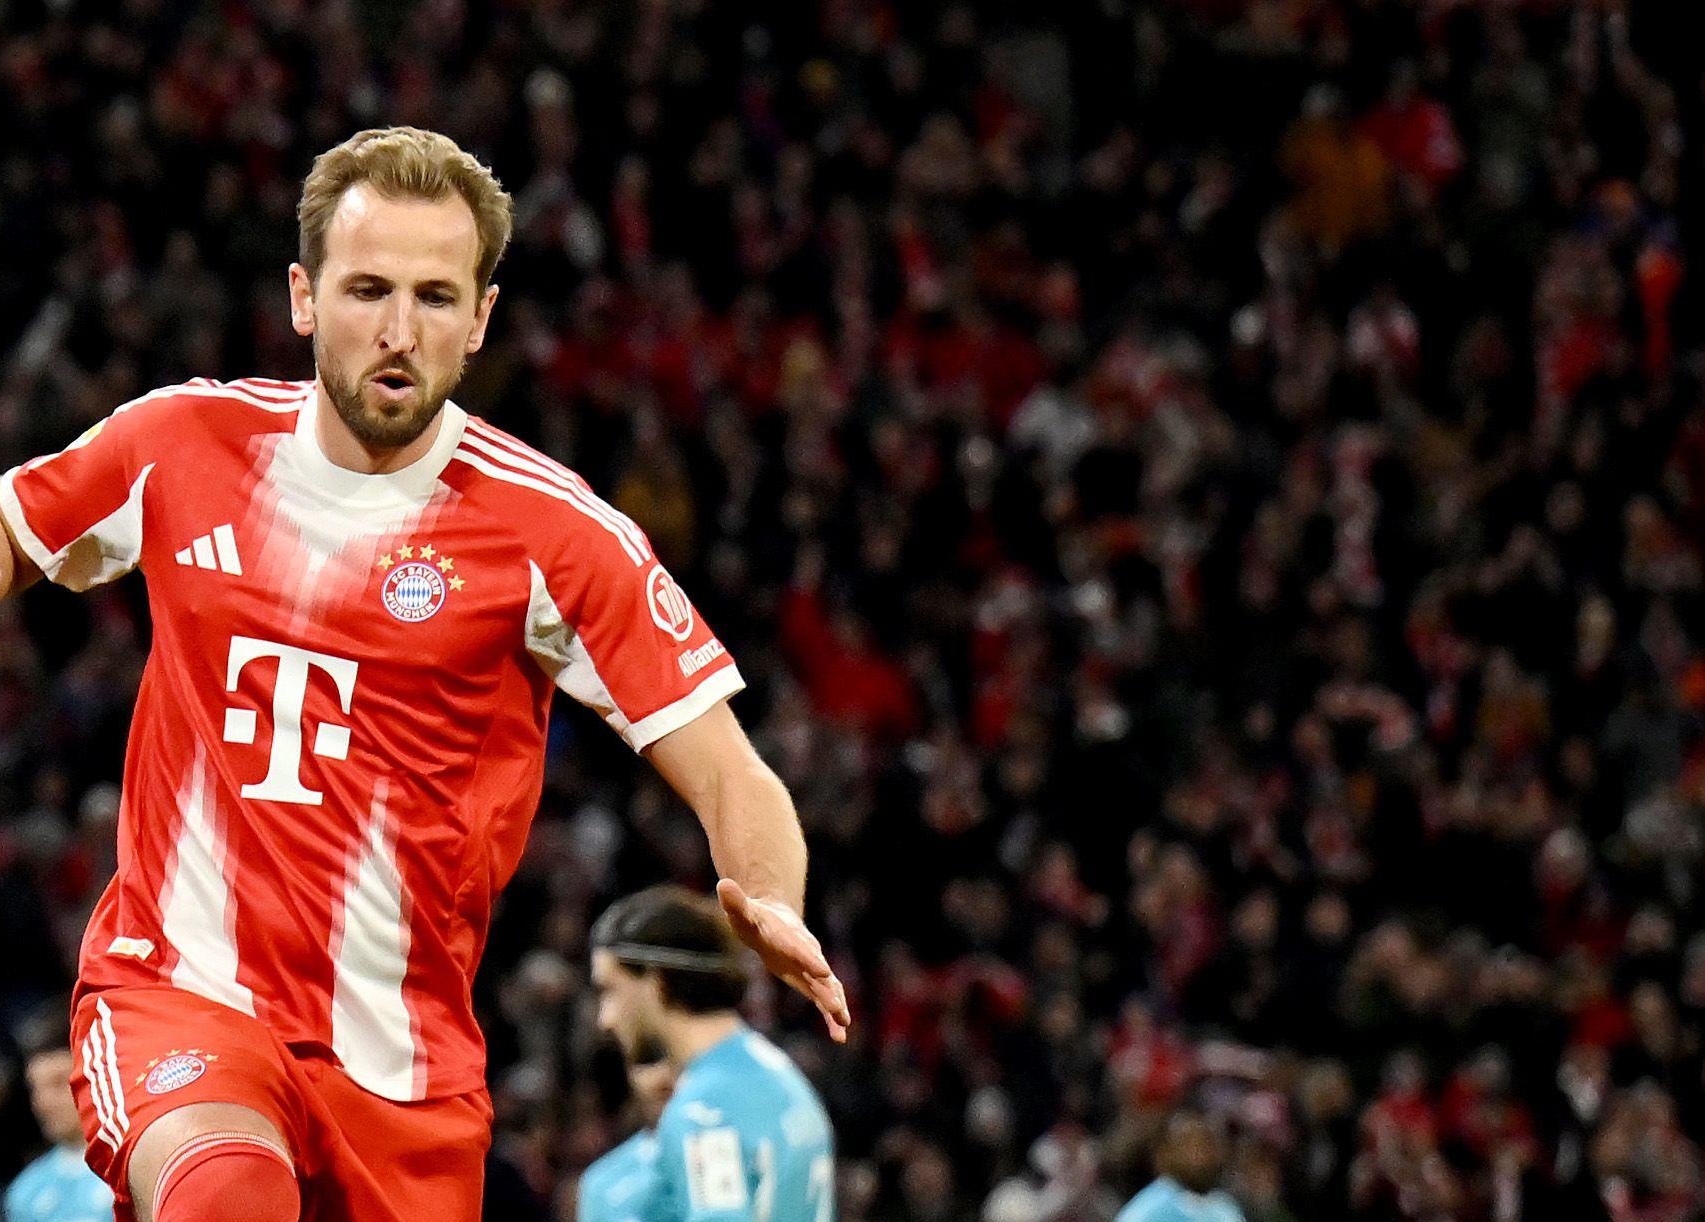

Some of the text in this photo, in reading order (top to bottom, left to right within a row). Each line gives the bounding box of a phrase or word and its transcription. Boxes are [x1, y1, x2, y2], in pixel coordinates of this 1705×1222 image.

[391, 566, 442, 595] FC BAYERN
[678, 637, 726, 678] Allianz
[223, 635, 358, 805] T
